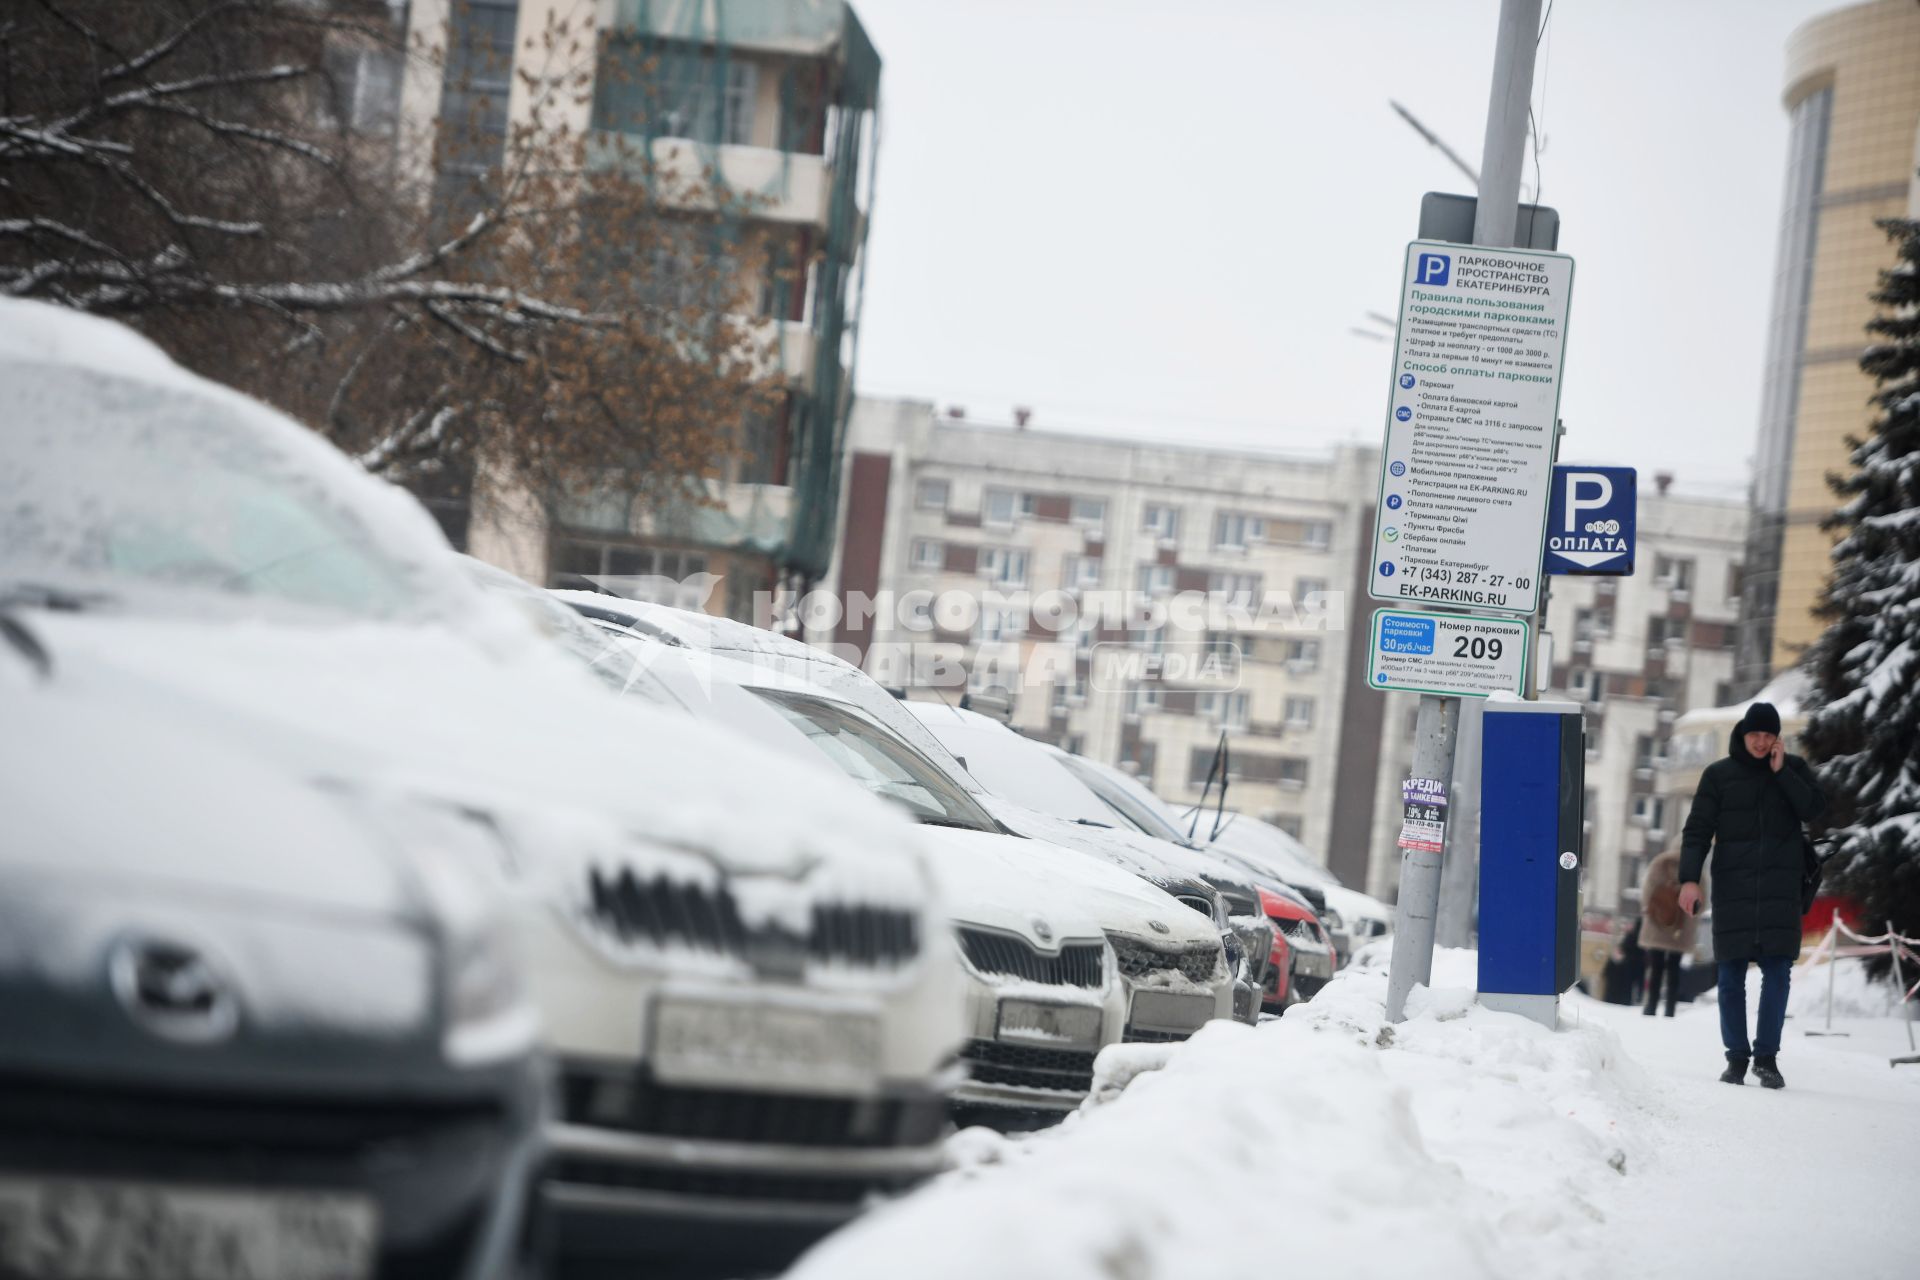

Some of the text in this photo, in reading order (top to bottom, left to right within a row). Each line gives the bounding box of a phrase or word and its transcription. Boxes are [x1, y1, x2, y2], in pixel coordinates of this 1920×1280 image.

[1458, 255, 1545, 272] ПАРКОВОЧНОЕ
[1457, 267, 1549, 284] ПРОСТРАНСТВО
[1456, 278, 1550, 296] ЕКАТЕРИНБУРГА
[1411, 289, 1544, 312] Правила пользования
[1409, 304, 1555, 325] городскими парковками
[1411, 327, 1441, 336] платное
[1449, 331, 1477, 340] требует
[1478, 334, 1523, 344] предоплаты
[1412, 316, 1558, 339] Размещение транспортных средств (ТС)
[1409, 337, 1436, 347] Штраф
[1446, 342, 1481, 352] неоплату
[1497, 346, 1513, 354] 1000
[1525, 349, 1542, 357] 3000
[1408, 348, 1430, 358] Плата
[1441, 353, 1469, 361] первые
[1480, 357, 1502, 366] минут
[1514, 361, 1552, 369] взимается
[1403, 360, 1552, 384] Способ оплаты парковки
[1419, 379, 1454, 389] Паркомат
[1422, 392, 1449, 402] Оплата
[1449, 395, 1492, 406] банковской
[1420, 402, 1481, 415] Оплата Е-картой
[1416, 412, 1454, 423] Отправьте
[1455, 416, 1472, 424] СМС
[1508, 423, 1543, 432] запросом
[1410, 466, 1497, 482] Мобильное приложение
[1412, 478, 1458, 489] Регистрация
[1469, 484, 1527, 496] EK-PARKING.RU
[1406, 499, 1477, 513] Оплата наличными
[1456, 495, 1491, 504] лицевого
[1492, 498, 1512, 506] счета
[1565, 473, 1612, 532] P
[1409, 510, 1451, 522] Терминалы
[1407, 521, 1464, 534] Пункты Фрисби
[1606, 523, 1618, 531] 20
[1403, 532, 1466, 546] Сбербанк онлайн
[1550, 537, 1627, 551] ОПЛАТА
[1405, 544, 1436, 554] Платежи
[1404, 555, 1489, 571] Парковки Екатеринбург
[1401, 566, 1417, 578] +7
[1420, 567, 1451, 584] (343)
[1456, 571, 1478, 584] 287
[1489, 574, 1504, 587] 27
[1515, 577, 1530, 590] 00
[1399, 583, 1506, 606] EK-PARKING.RU
[1384, 618, 1430, 630] Стоимость
[1439, 621, 1520, 635] Номер парковки
[1384, 628, 1422, 637] парковки
[1383, 638, 1431, 653] 30 руб./час
[1453, 635, 1502, 660] 209
[1381, 654, 1406, 663] Пример
